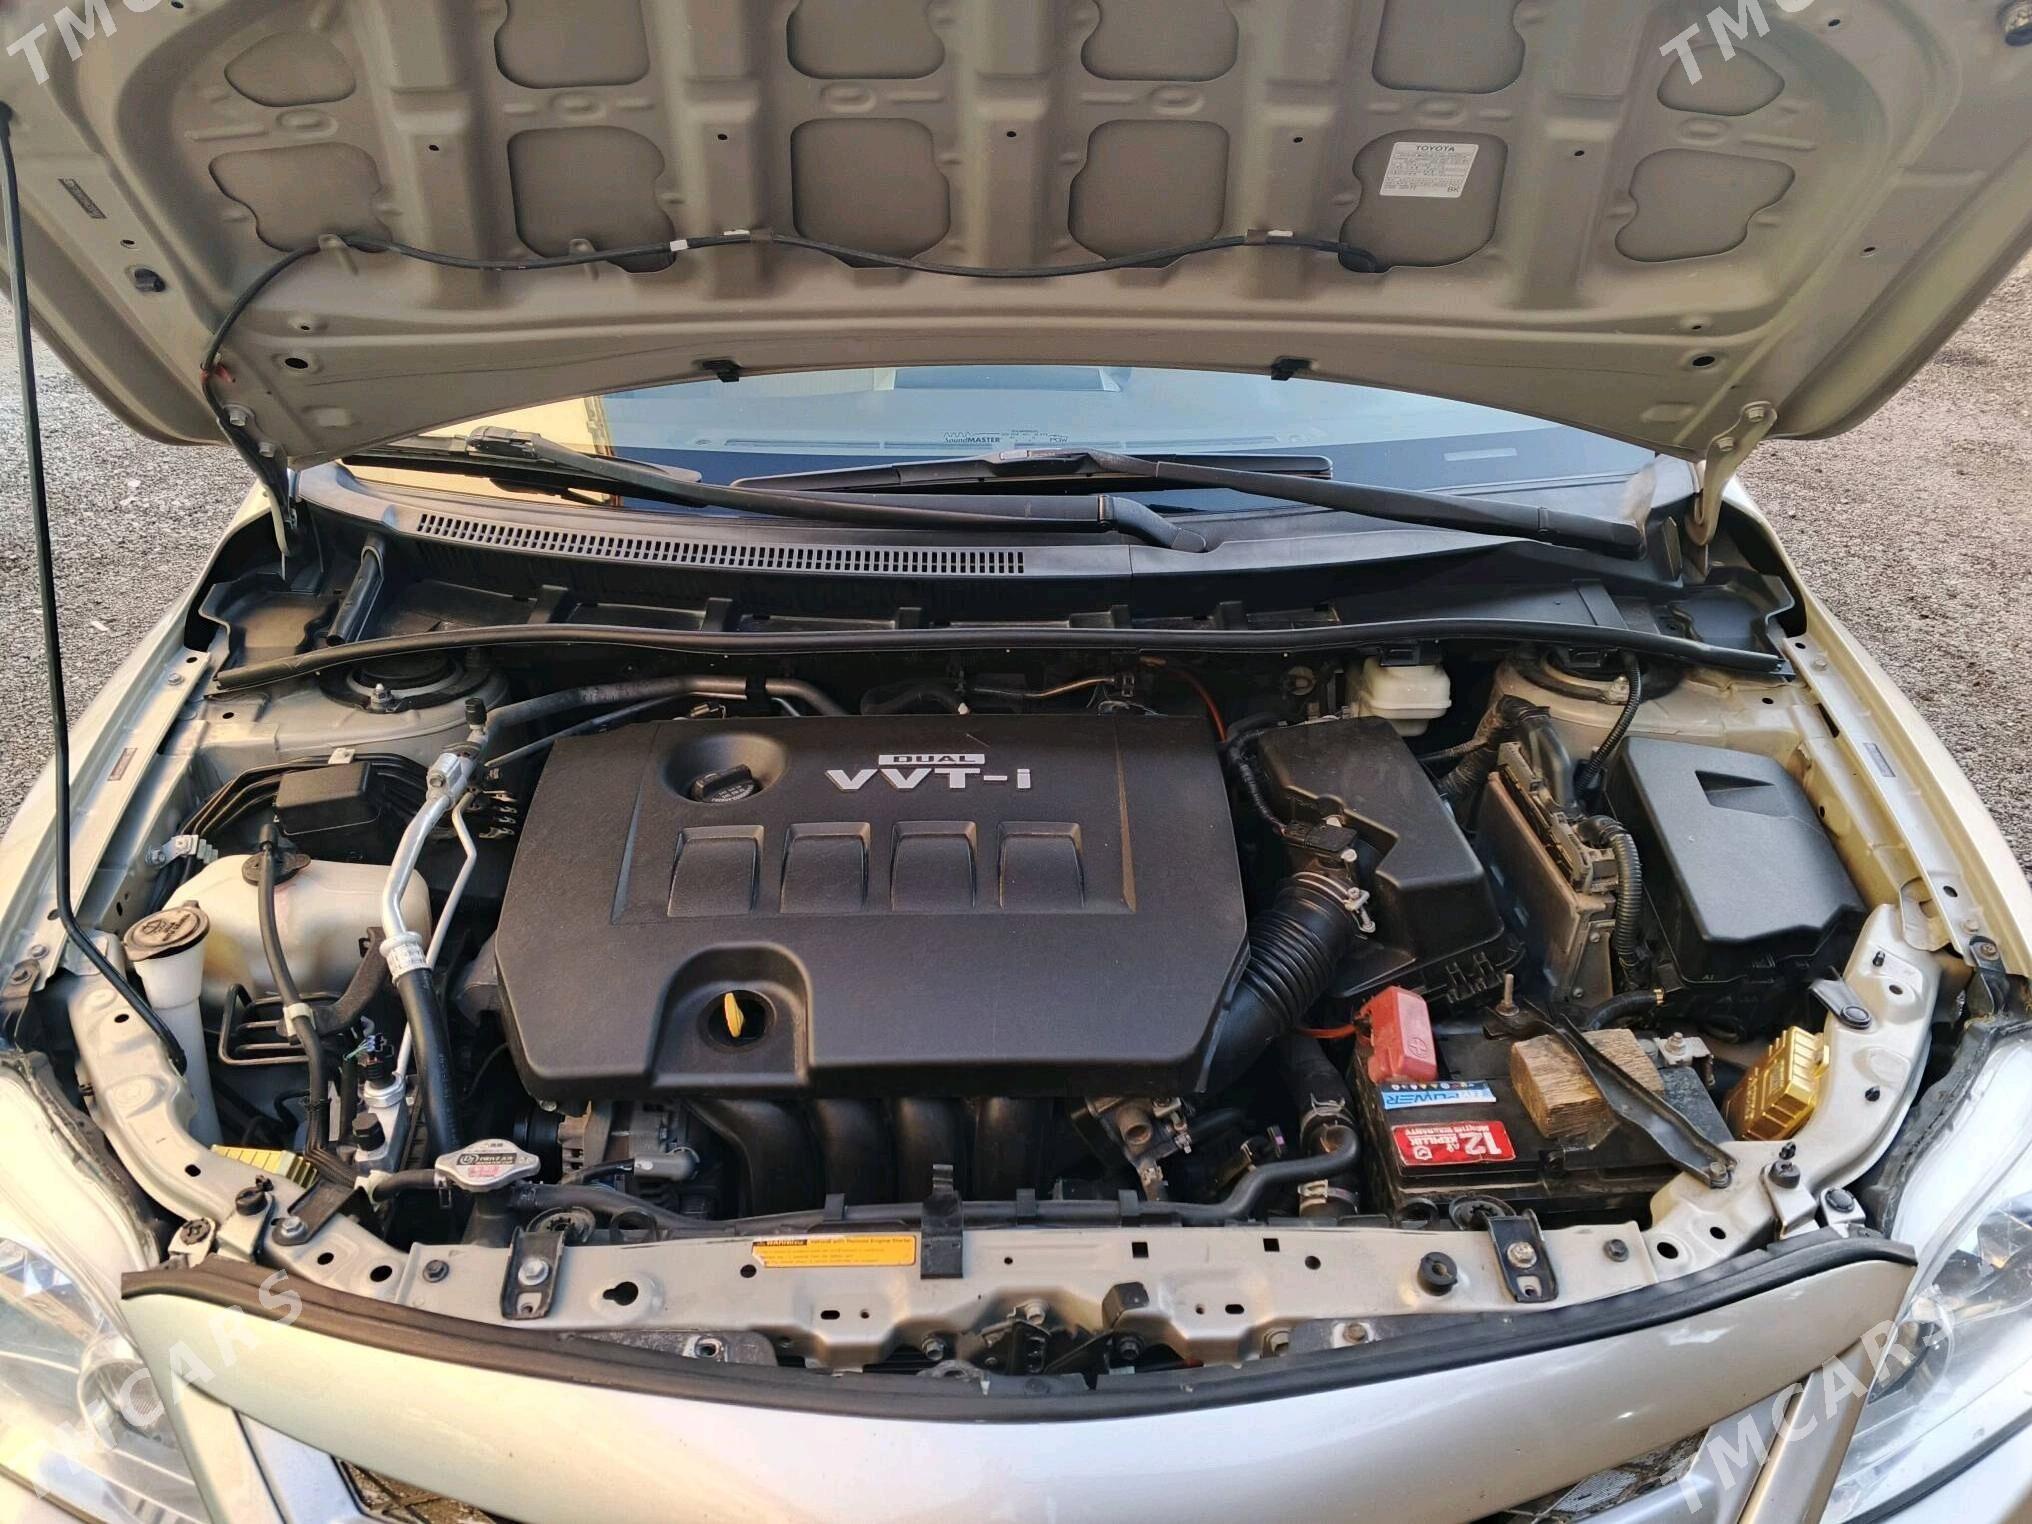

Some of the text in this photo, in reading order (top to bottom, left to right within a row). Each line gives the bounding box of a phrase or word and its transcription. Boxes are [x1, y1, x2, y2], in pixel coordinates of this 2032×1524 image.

[893, 755, 976, 763] DUAL
[824, 767, 1032, 792] VVT-i
[1459, 1132, 1504, 1156] 12
